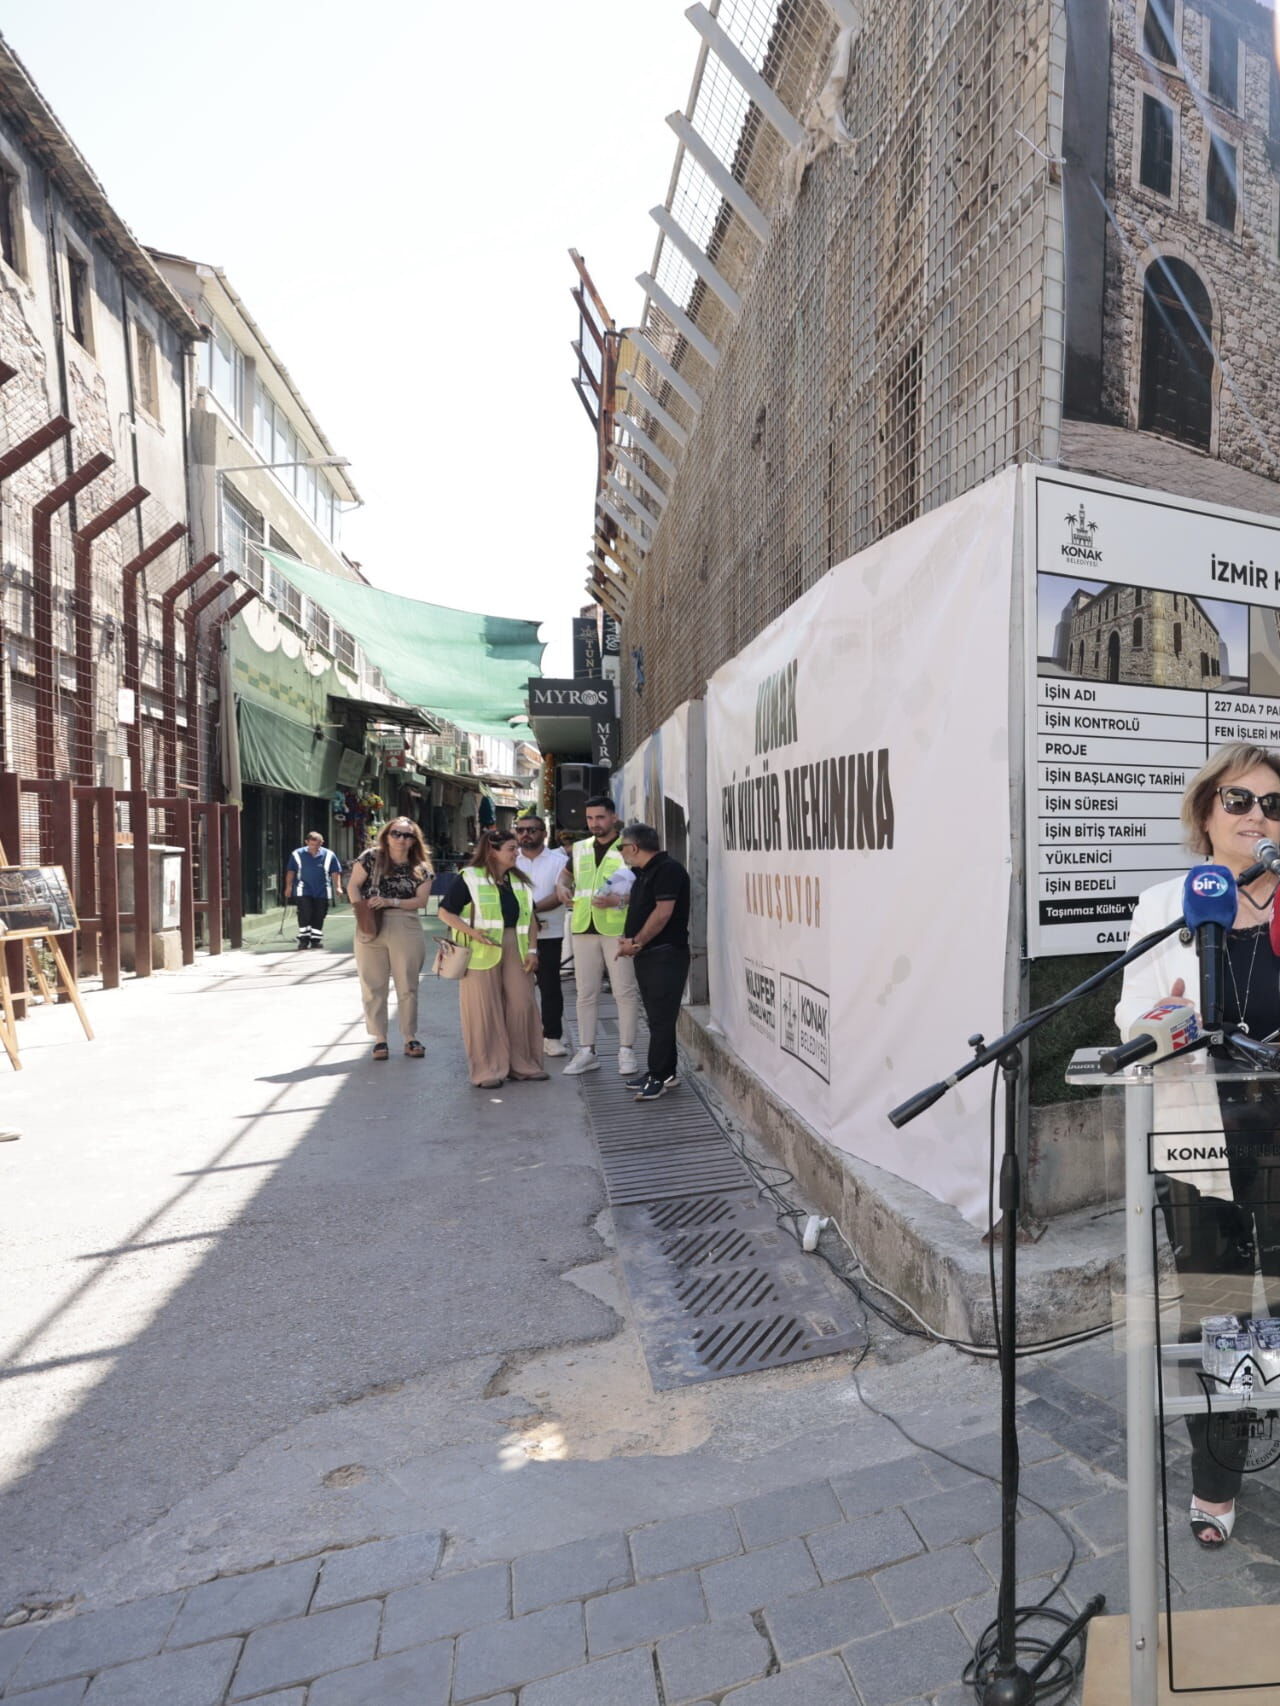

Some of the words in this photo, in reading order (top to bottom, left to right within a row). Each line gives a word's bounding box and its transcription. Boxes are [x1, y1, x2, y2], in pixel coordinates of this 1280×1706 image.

[1061, 544, 1103, 562] KONAK
[1210, 553, 1268, 589] İZMİR
[534, 689, 608, 706] MYROS
[1045, 683, 1071, 701] İŞİN
[1074, 690, 1096, 702] ADI
[755, 658, 798, 756] KONAK
[1214, 701, 1232, 712] 227
[1234, 703, 1256, 715] ADA
[1258, 705, 1264, 715] 7
[1045, 711, 1071, 729] İŞİN
[1074, 717, 1140, 731] KONTROLÜ
[1214, 726, 1234, 738] FEN
[1237, 725, 1268, 741] İŞLERİ
[1045, 742, 1087, 756] PROJE
[1045, 767, 1071, 785] İŞİN
[1074, 771, 1146, 787] BAŞLANGIÇ
[1149, 772, 1185, 786] TARİHİ
[738, 759, 782, 852] KÜLTÜR
[784, 748, 895, 851] MEKANINA
[1045, 795, 1071, 812] İŞİN
[1074, 796, 1118, 811] SÜRESİ
[1045, 823, 1071, 840] İŞİN
[1074, 823, 1106, 839] BİTİŞ
[1108, 823, 1146, 837] TARİHİ
[1045, 849, 1112, 865] YÜKLENİCİ
[1045, 878, 1071, 895] İŞİN
[1074, 876, 1116, 892] BEDELİ
[746, 872, 820, 929] KAVUŞUYOR
[1046, 906, 1094, 919] Taşınmaz
[1096, 903, 1126, 915] Kültür
[801, 995, 827, 1040] KONAK
[1167, 1146, 1229, 1161] KONAK
